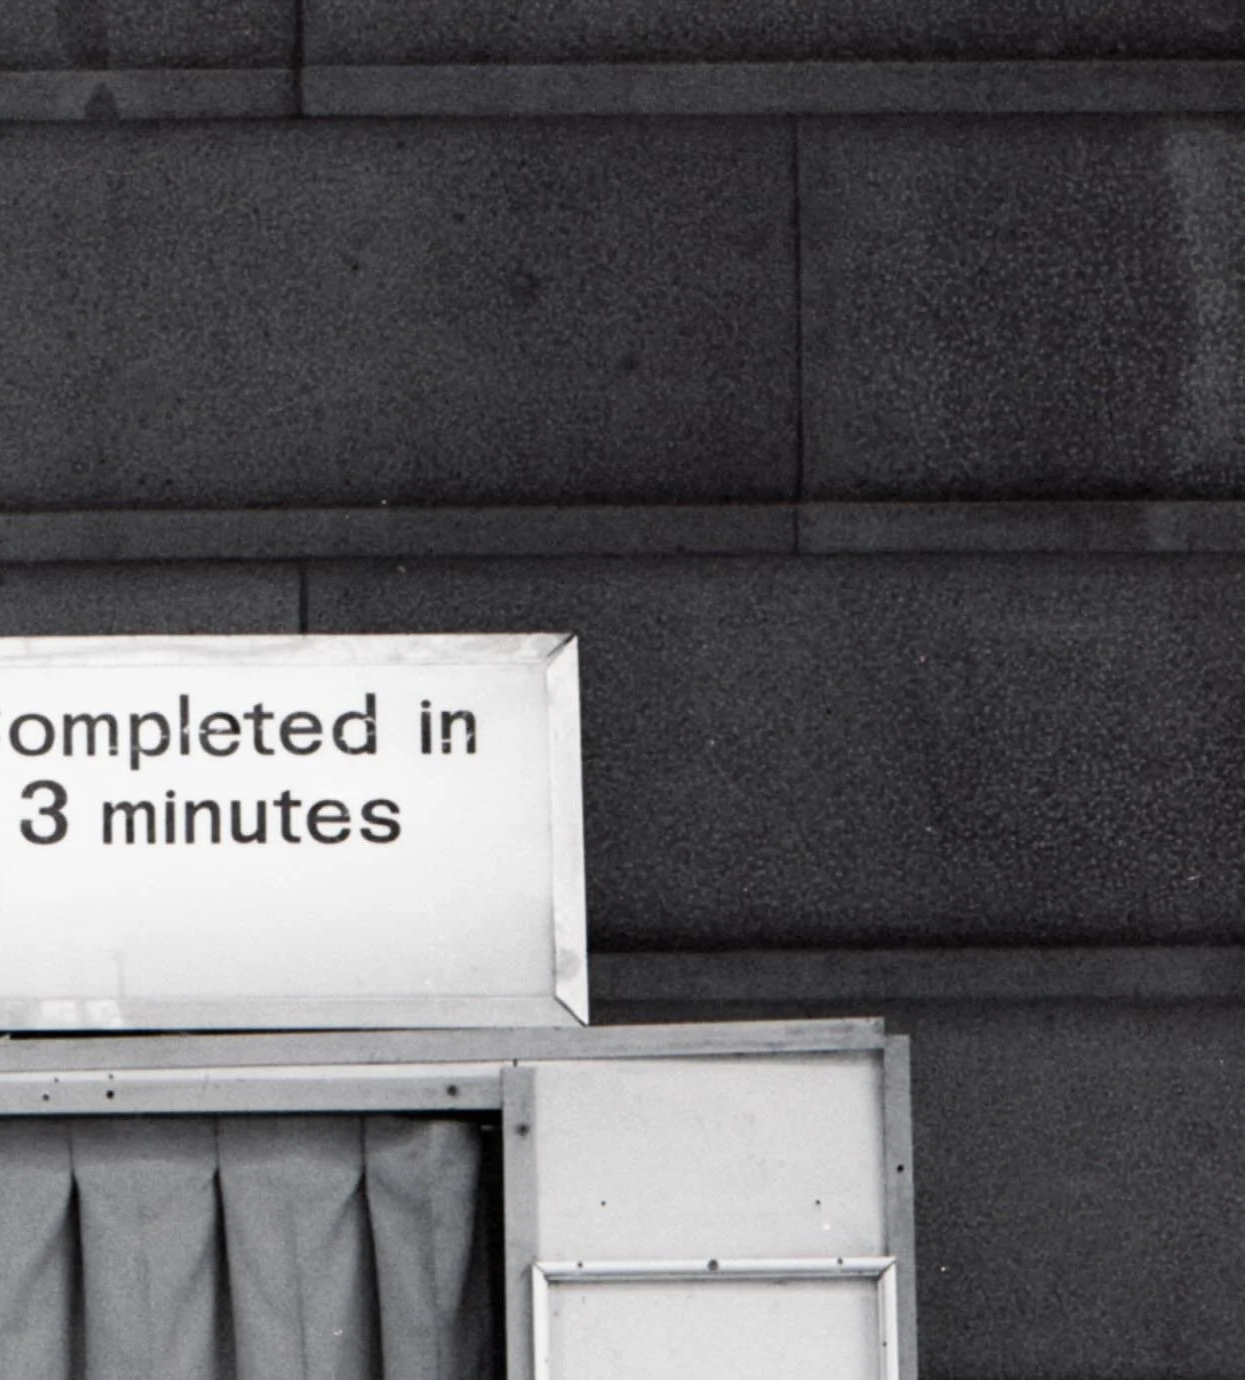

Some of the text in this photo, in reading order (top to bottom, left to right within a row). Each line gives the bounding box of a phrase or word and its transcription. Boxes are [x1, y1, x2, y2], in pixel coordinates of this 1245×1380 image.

[420, 700, 478, 755] in
[19, 779, 403, 845] 3 minutes
